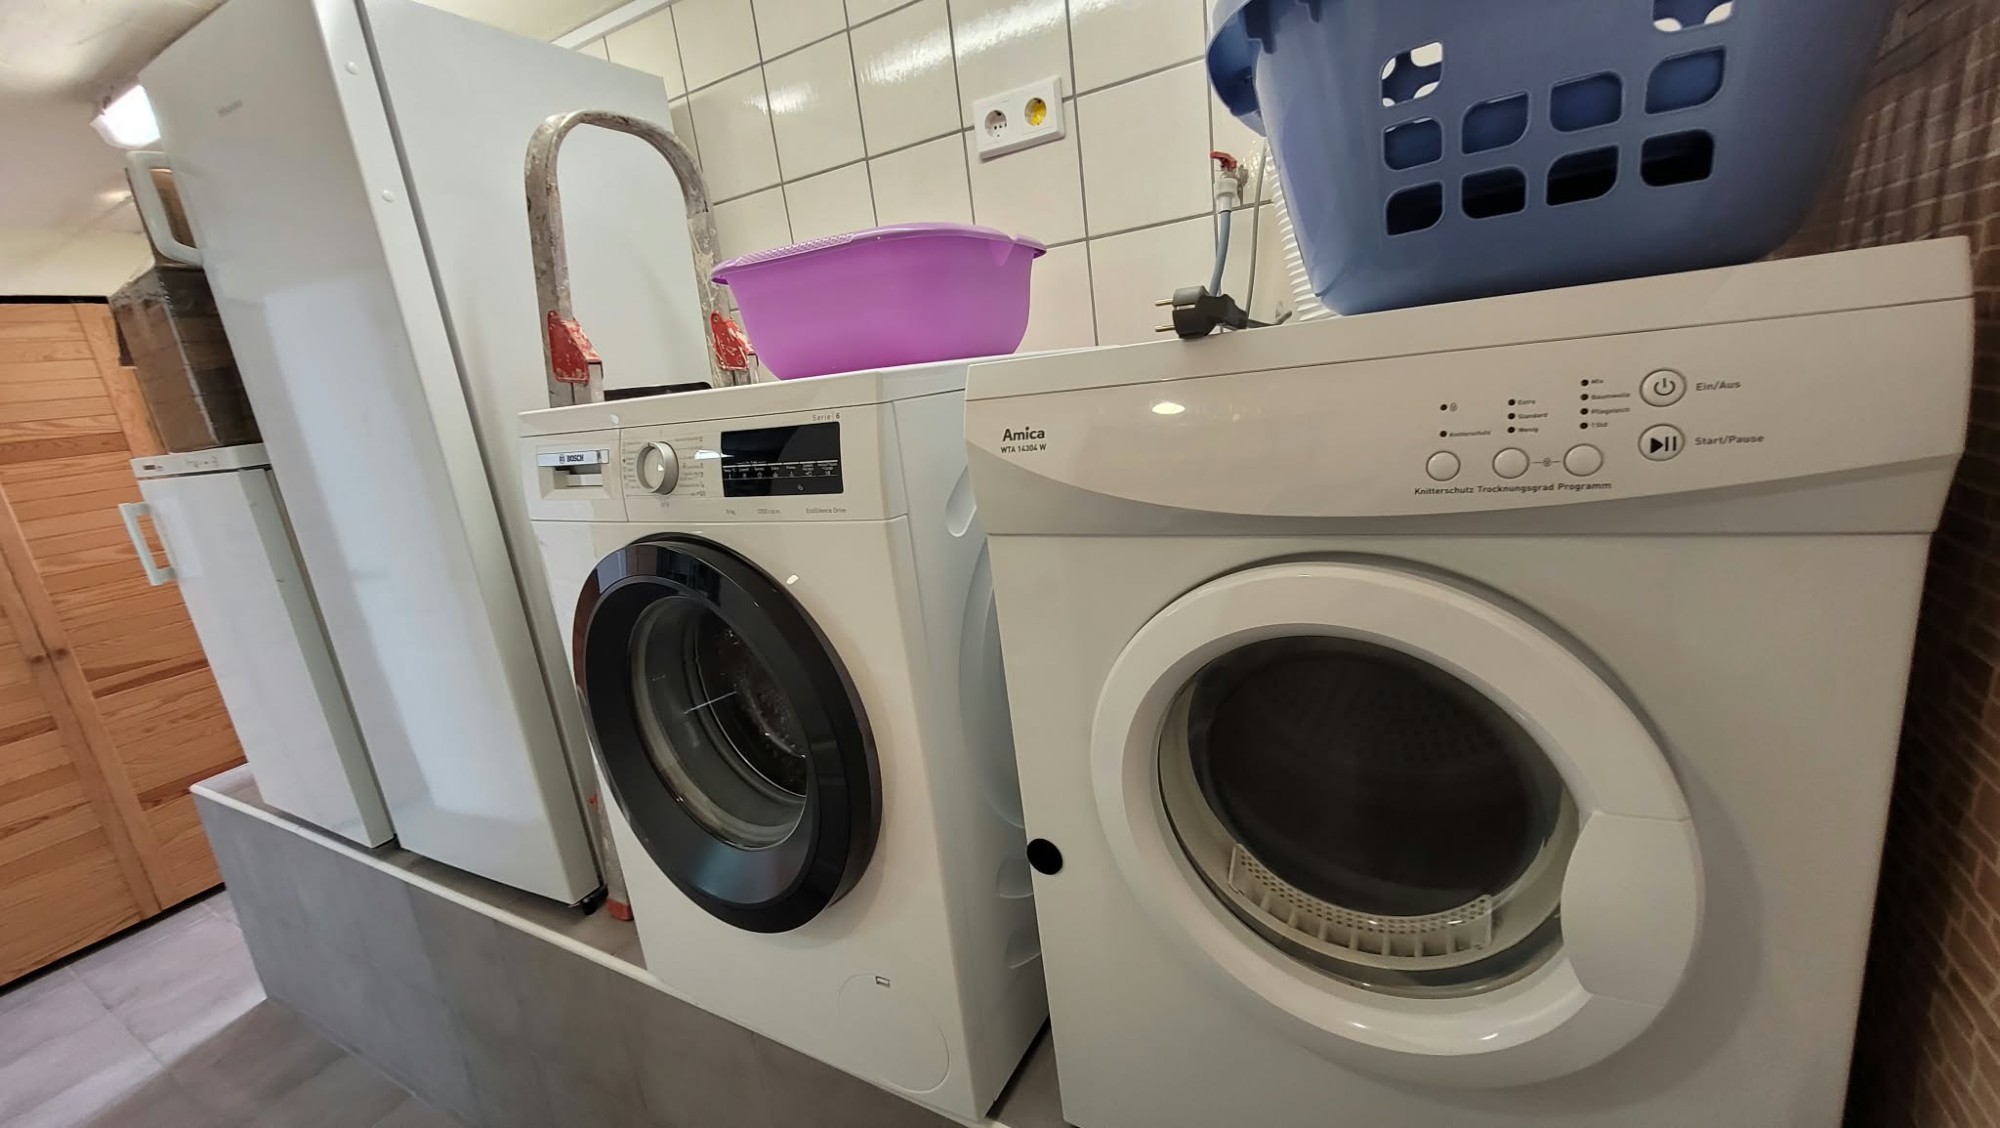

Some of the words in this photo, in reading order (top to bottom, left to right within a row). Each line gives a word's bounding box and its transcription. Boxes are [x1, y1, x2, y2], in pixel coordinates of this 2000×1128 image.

[1695, 381, 1742, 391] Ein/Aus
[1002, 426, 1046, 441] Amica
[1694, 435, 1765, 446] Start/Pause
[1000, 445, 1016, 453] WTA
[1039, 443, 1047, 451] W
[566, 454, 584, 462] BOSCH
[1414, 486, 1474, 496] Knitterschutz
[1477, 484, 1554, 493] Trocknungsgrad
[1557, 482, 1612, 491] Programm
